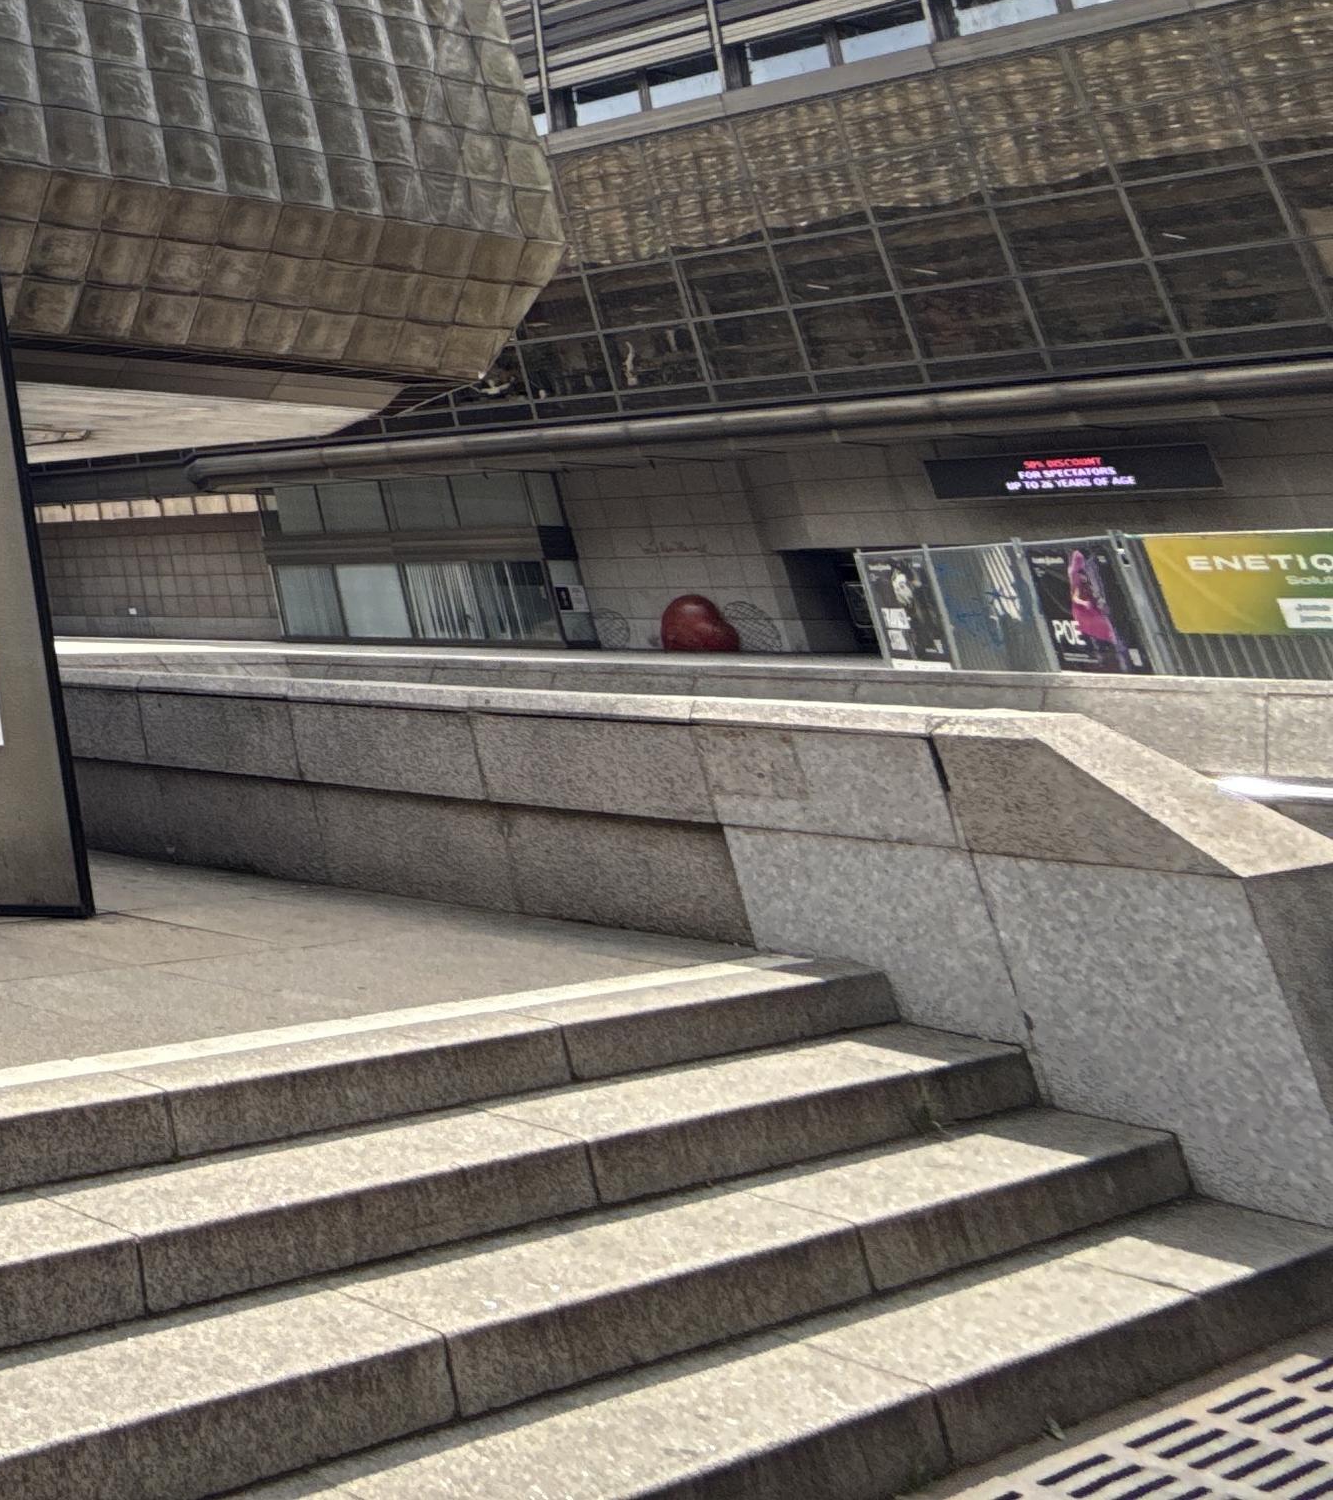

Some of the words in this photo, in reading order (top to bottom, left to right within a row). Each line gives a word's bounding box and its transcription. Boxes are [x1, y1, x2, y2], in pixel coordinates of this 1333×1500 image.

[1046, 456, 1102, 468] DISCOUNT
[1017, 470, 1043, 480] FOR
[1042, 466, 1117, 478] SPECTATORS
[1005, 481, 1022, 490] UP
[1023, 480, 1040, 489] TO
[1055, 478, 1092, 488] YEARS
[1093, 476, 1109, 486] OF
[1111, 475, 1137, 485] AGE
[1186, 553, 1333, 573] ENETIQ
[1051, 619, 1087, 645] POE
